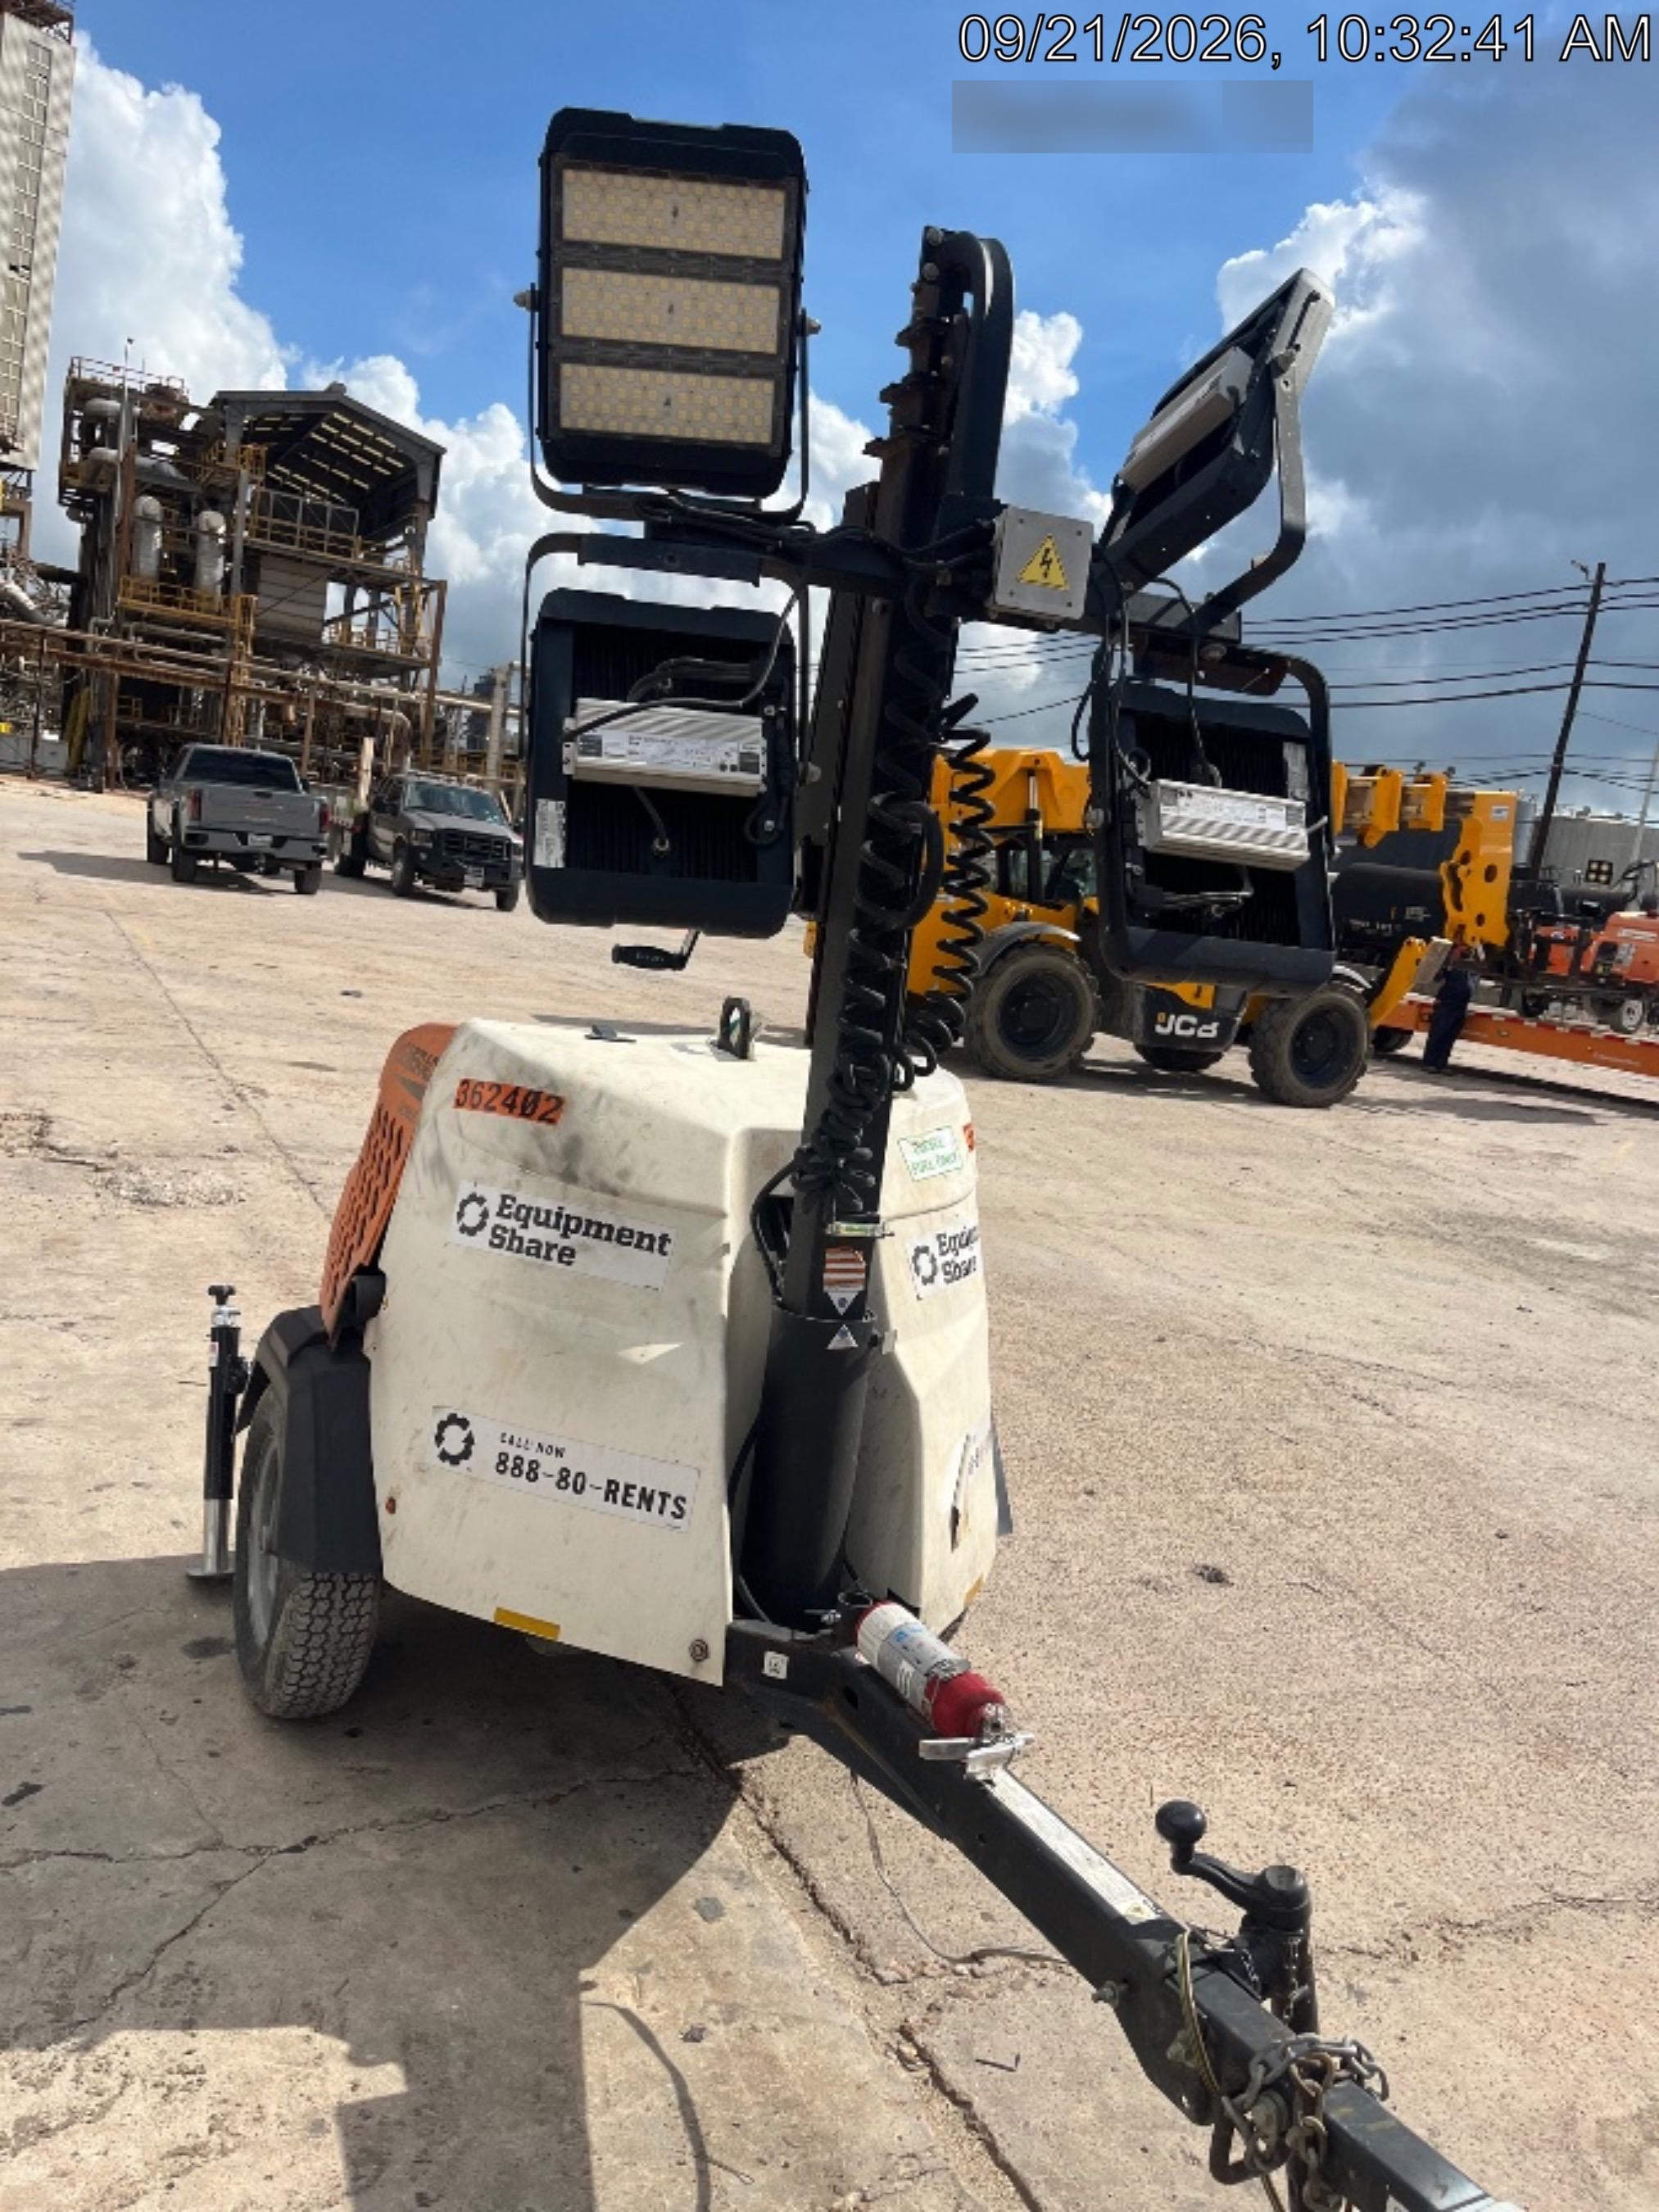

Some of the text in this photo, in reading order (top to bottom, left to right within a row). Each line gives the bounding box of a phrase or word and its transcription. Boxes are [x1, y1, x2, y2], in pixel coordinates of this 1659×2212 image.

[1155, 1013, 1220, 1038] JCB
[455, 1078, 565, 1124] 362402
[488, 1224, 576, 1266] Share
[496, 1194, 672, 1256] Equipment
[536, 1442, 565, 1457] NOW
[496, 1452, 687, 1520] 888-80-RENTS
